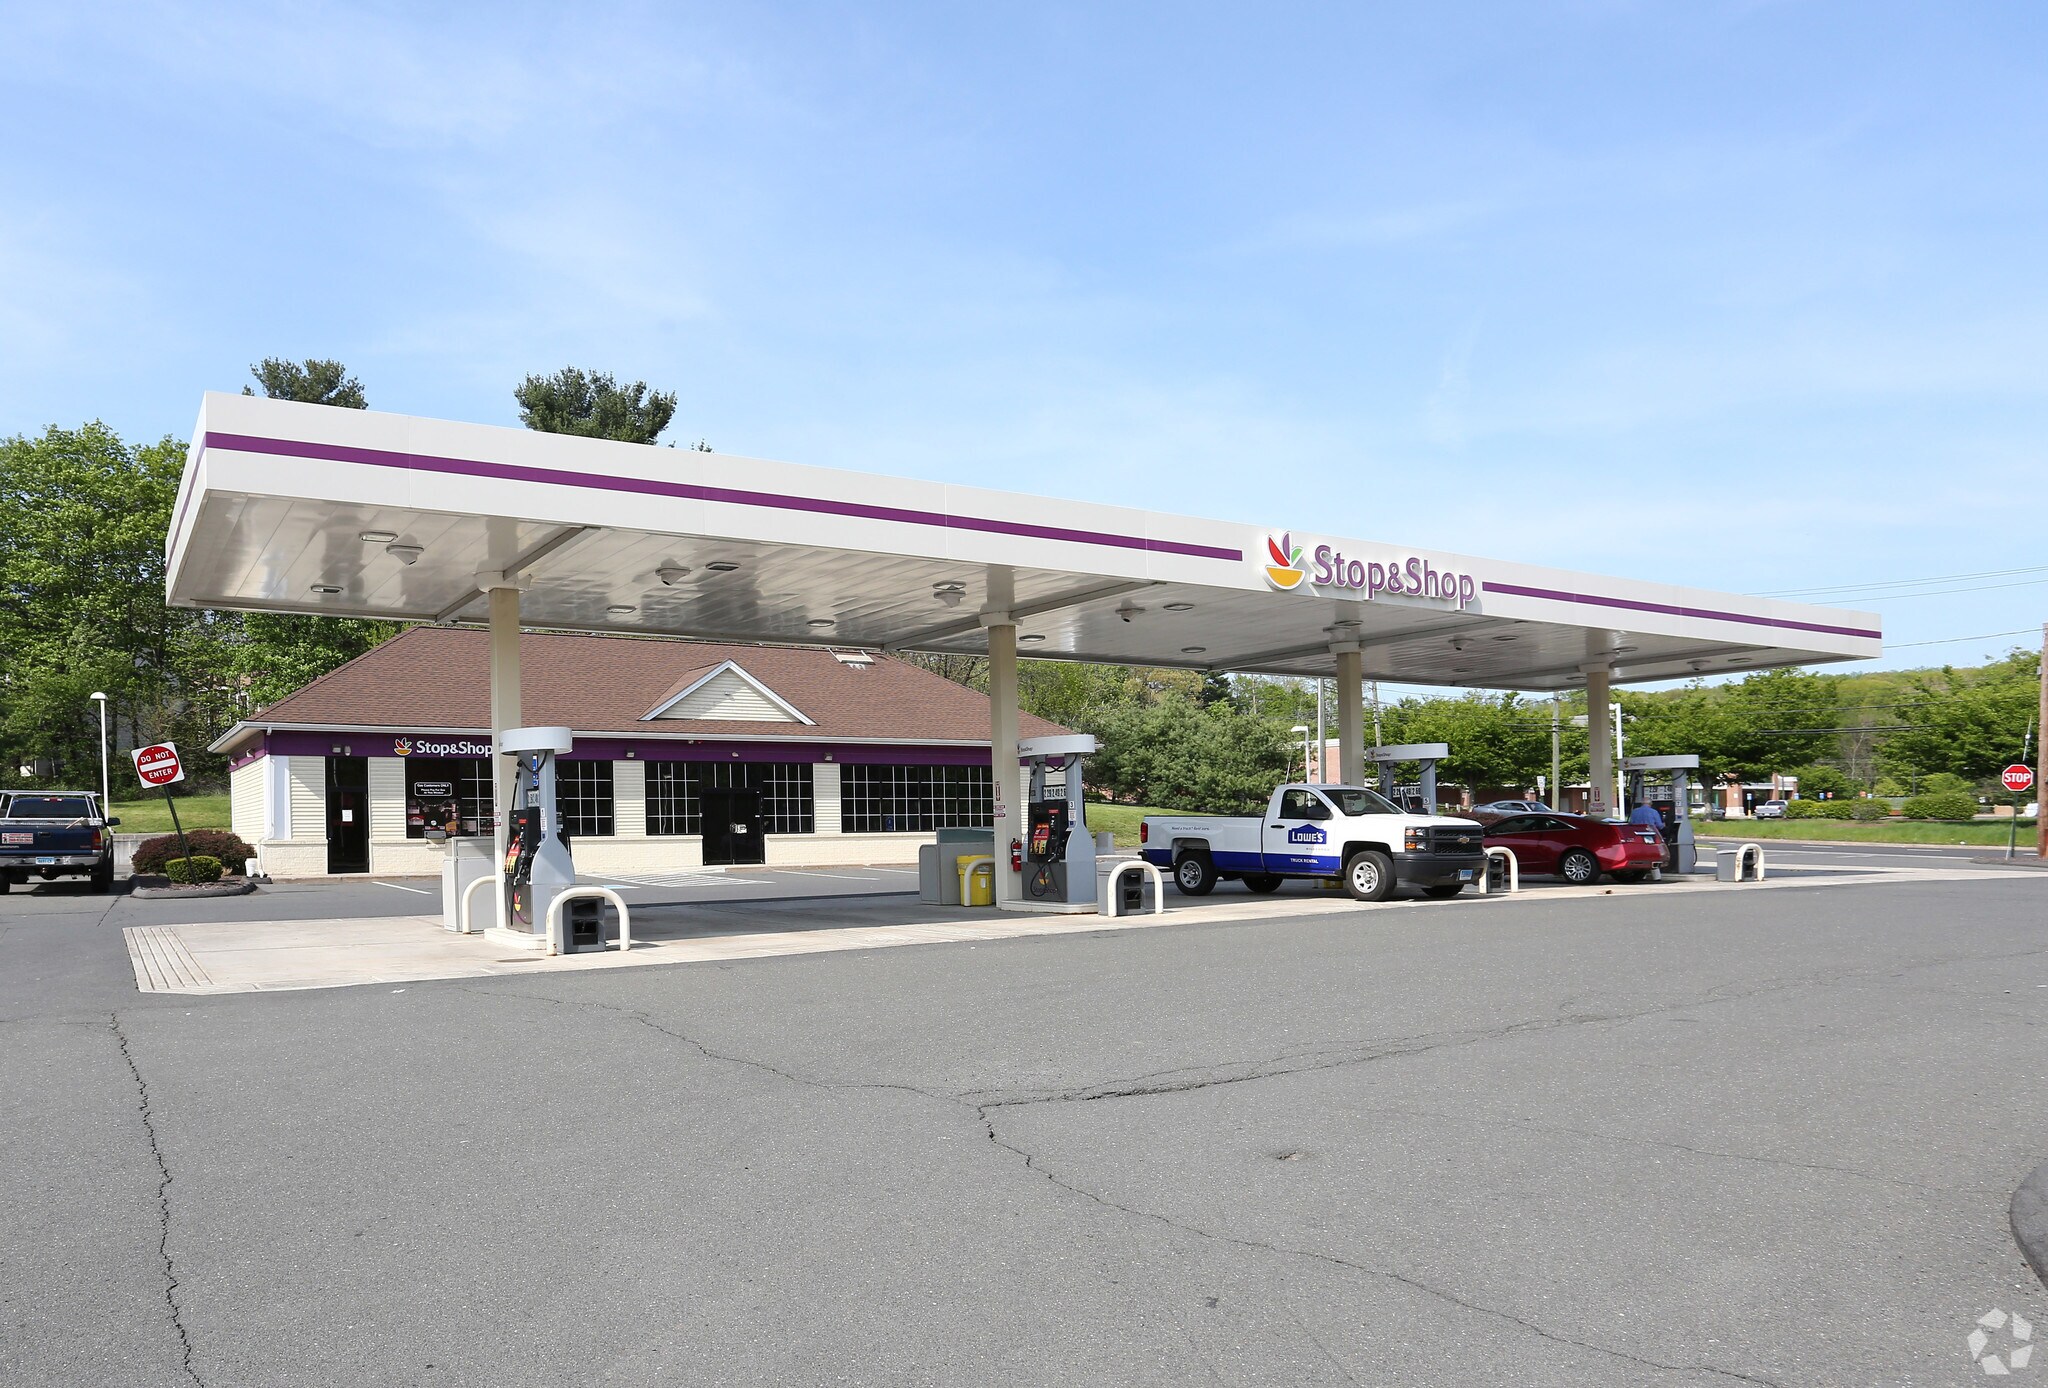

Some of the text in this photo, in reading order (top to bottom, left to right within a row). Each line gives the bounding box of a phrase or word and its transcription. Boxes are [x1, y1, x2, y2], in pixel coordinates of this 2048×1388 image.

[1314, 544, 1475, 609] Stop&Shop
[416, 740, 493, 758] Stop&Shop
[141, 751, 170, 763] DO NOT
[148, 768, 173, 779] ENTER
[2004, 772, 2031, 783] STOP
[1292, 831, 1324, 843] LOWE'S
